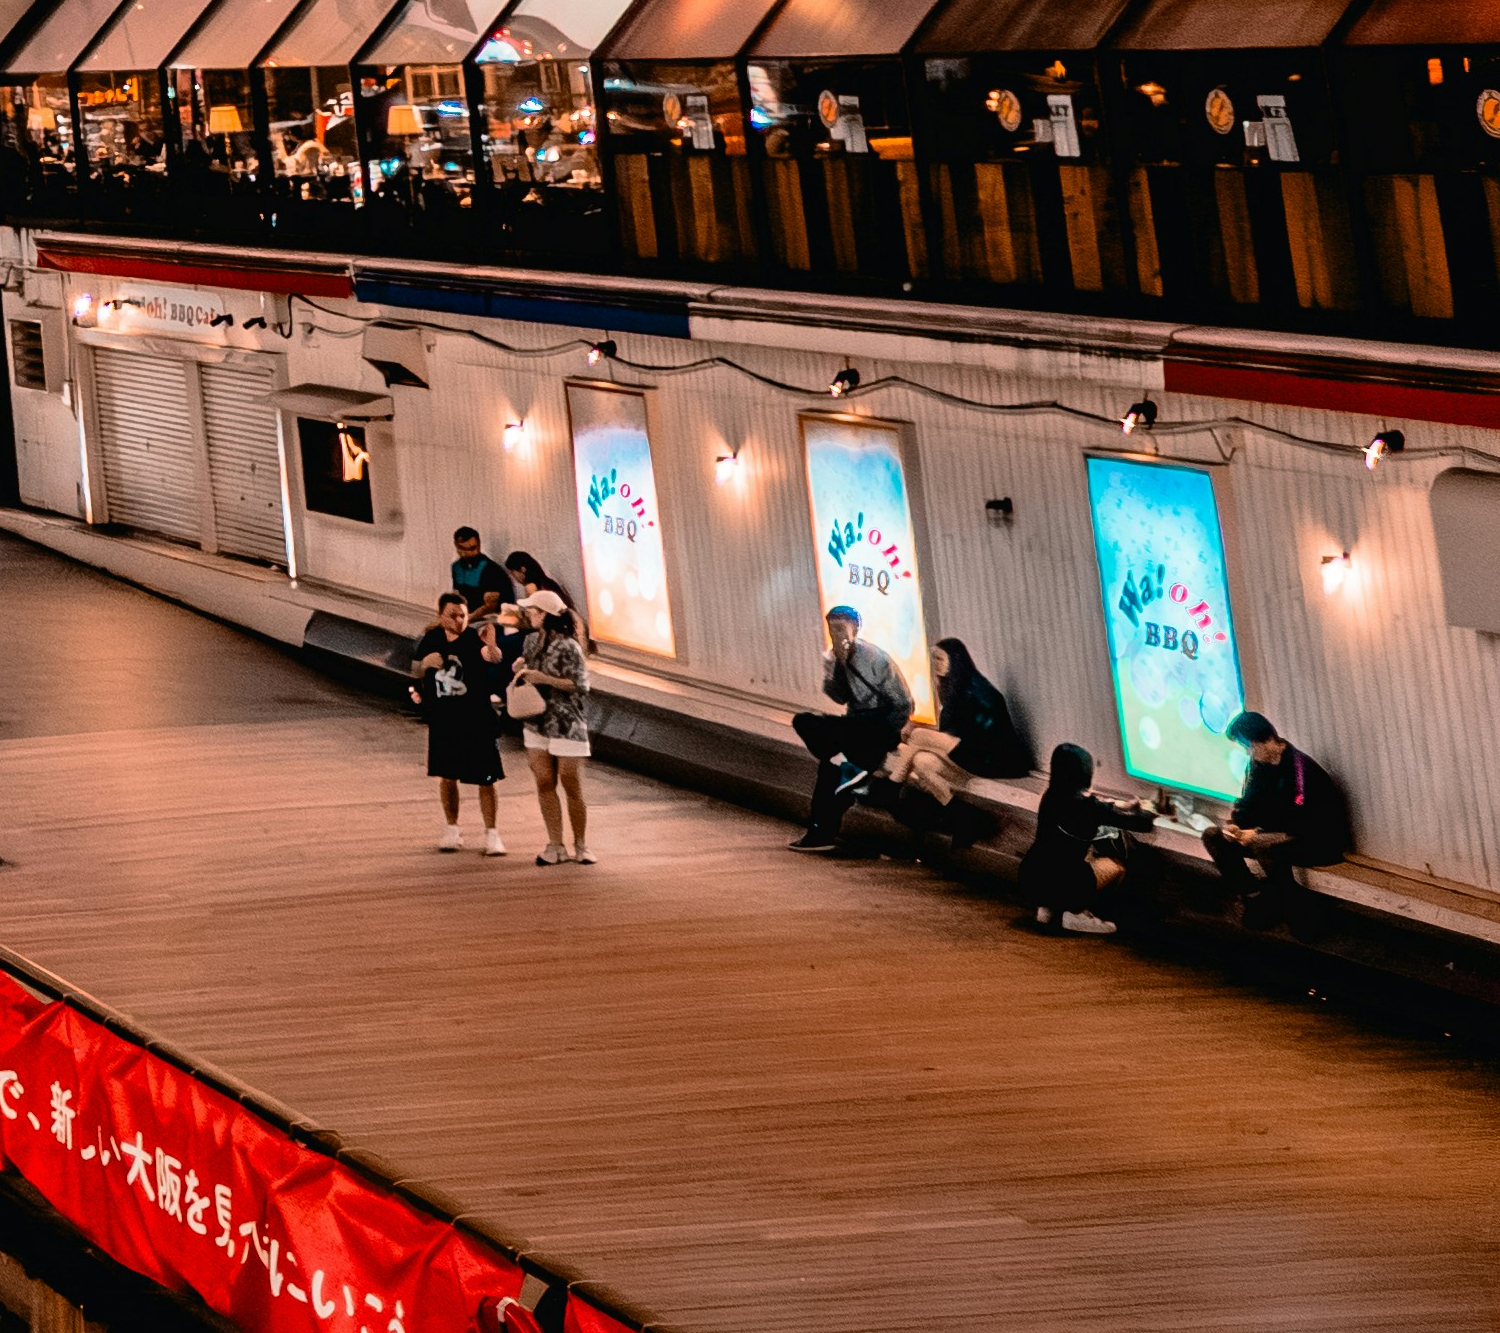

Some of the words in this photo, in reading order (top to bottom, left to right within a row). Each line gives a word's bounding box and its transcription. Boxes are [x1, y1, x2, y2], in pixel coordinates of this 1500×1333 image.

[603, 513, 638, 545] BBQ
[847, 564, 891, 597] BBQ
[1144, 621, 1200, 661] BBQ
